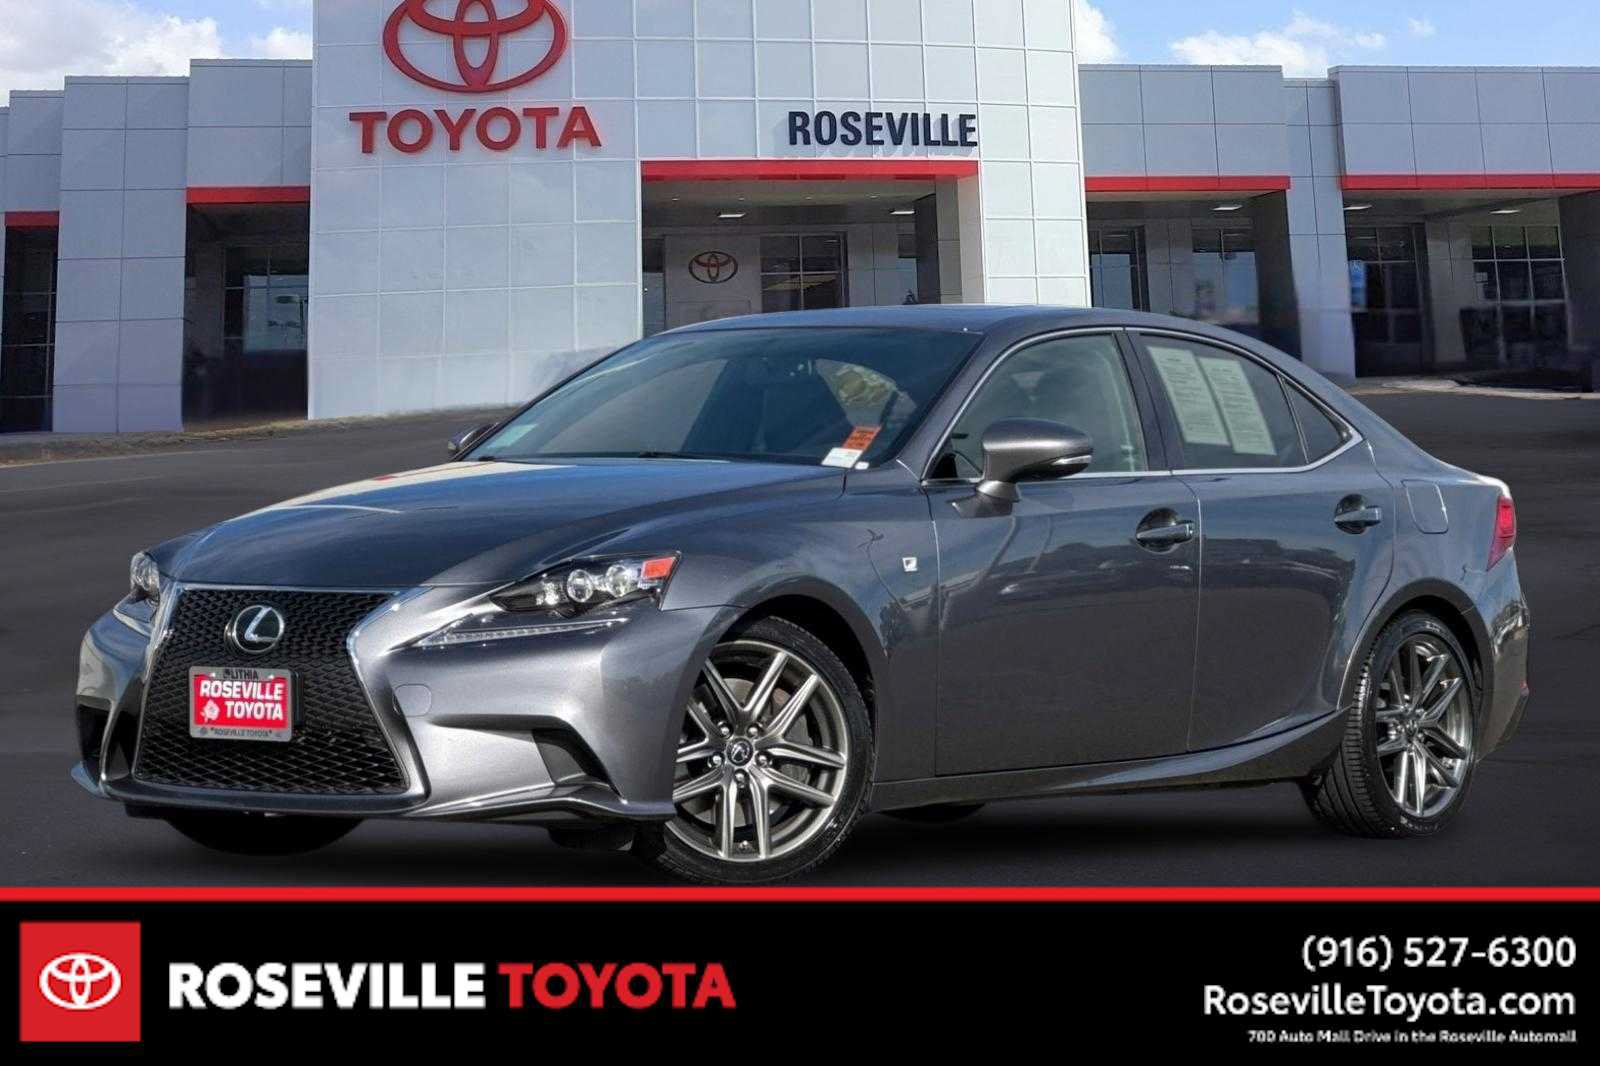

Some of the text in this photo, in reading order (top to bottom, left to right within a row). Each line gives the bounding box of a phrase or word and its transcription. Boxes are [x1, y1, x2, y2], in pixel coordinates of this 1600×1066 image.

[349, 106, 602, 154] TOYOTA
[788, 110, 978, 147] ROSEVILLE
[200, 680, 284, 700] ROSEVILLE
[224, 701, 284, 720] TOYOTA
